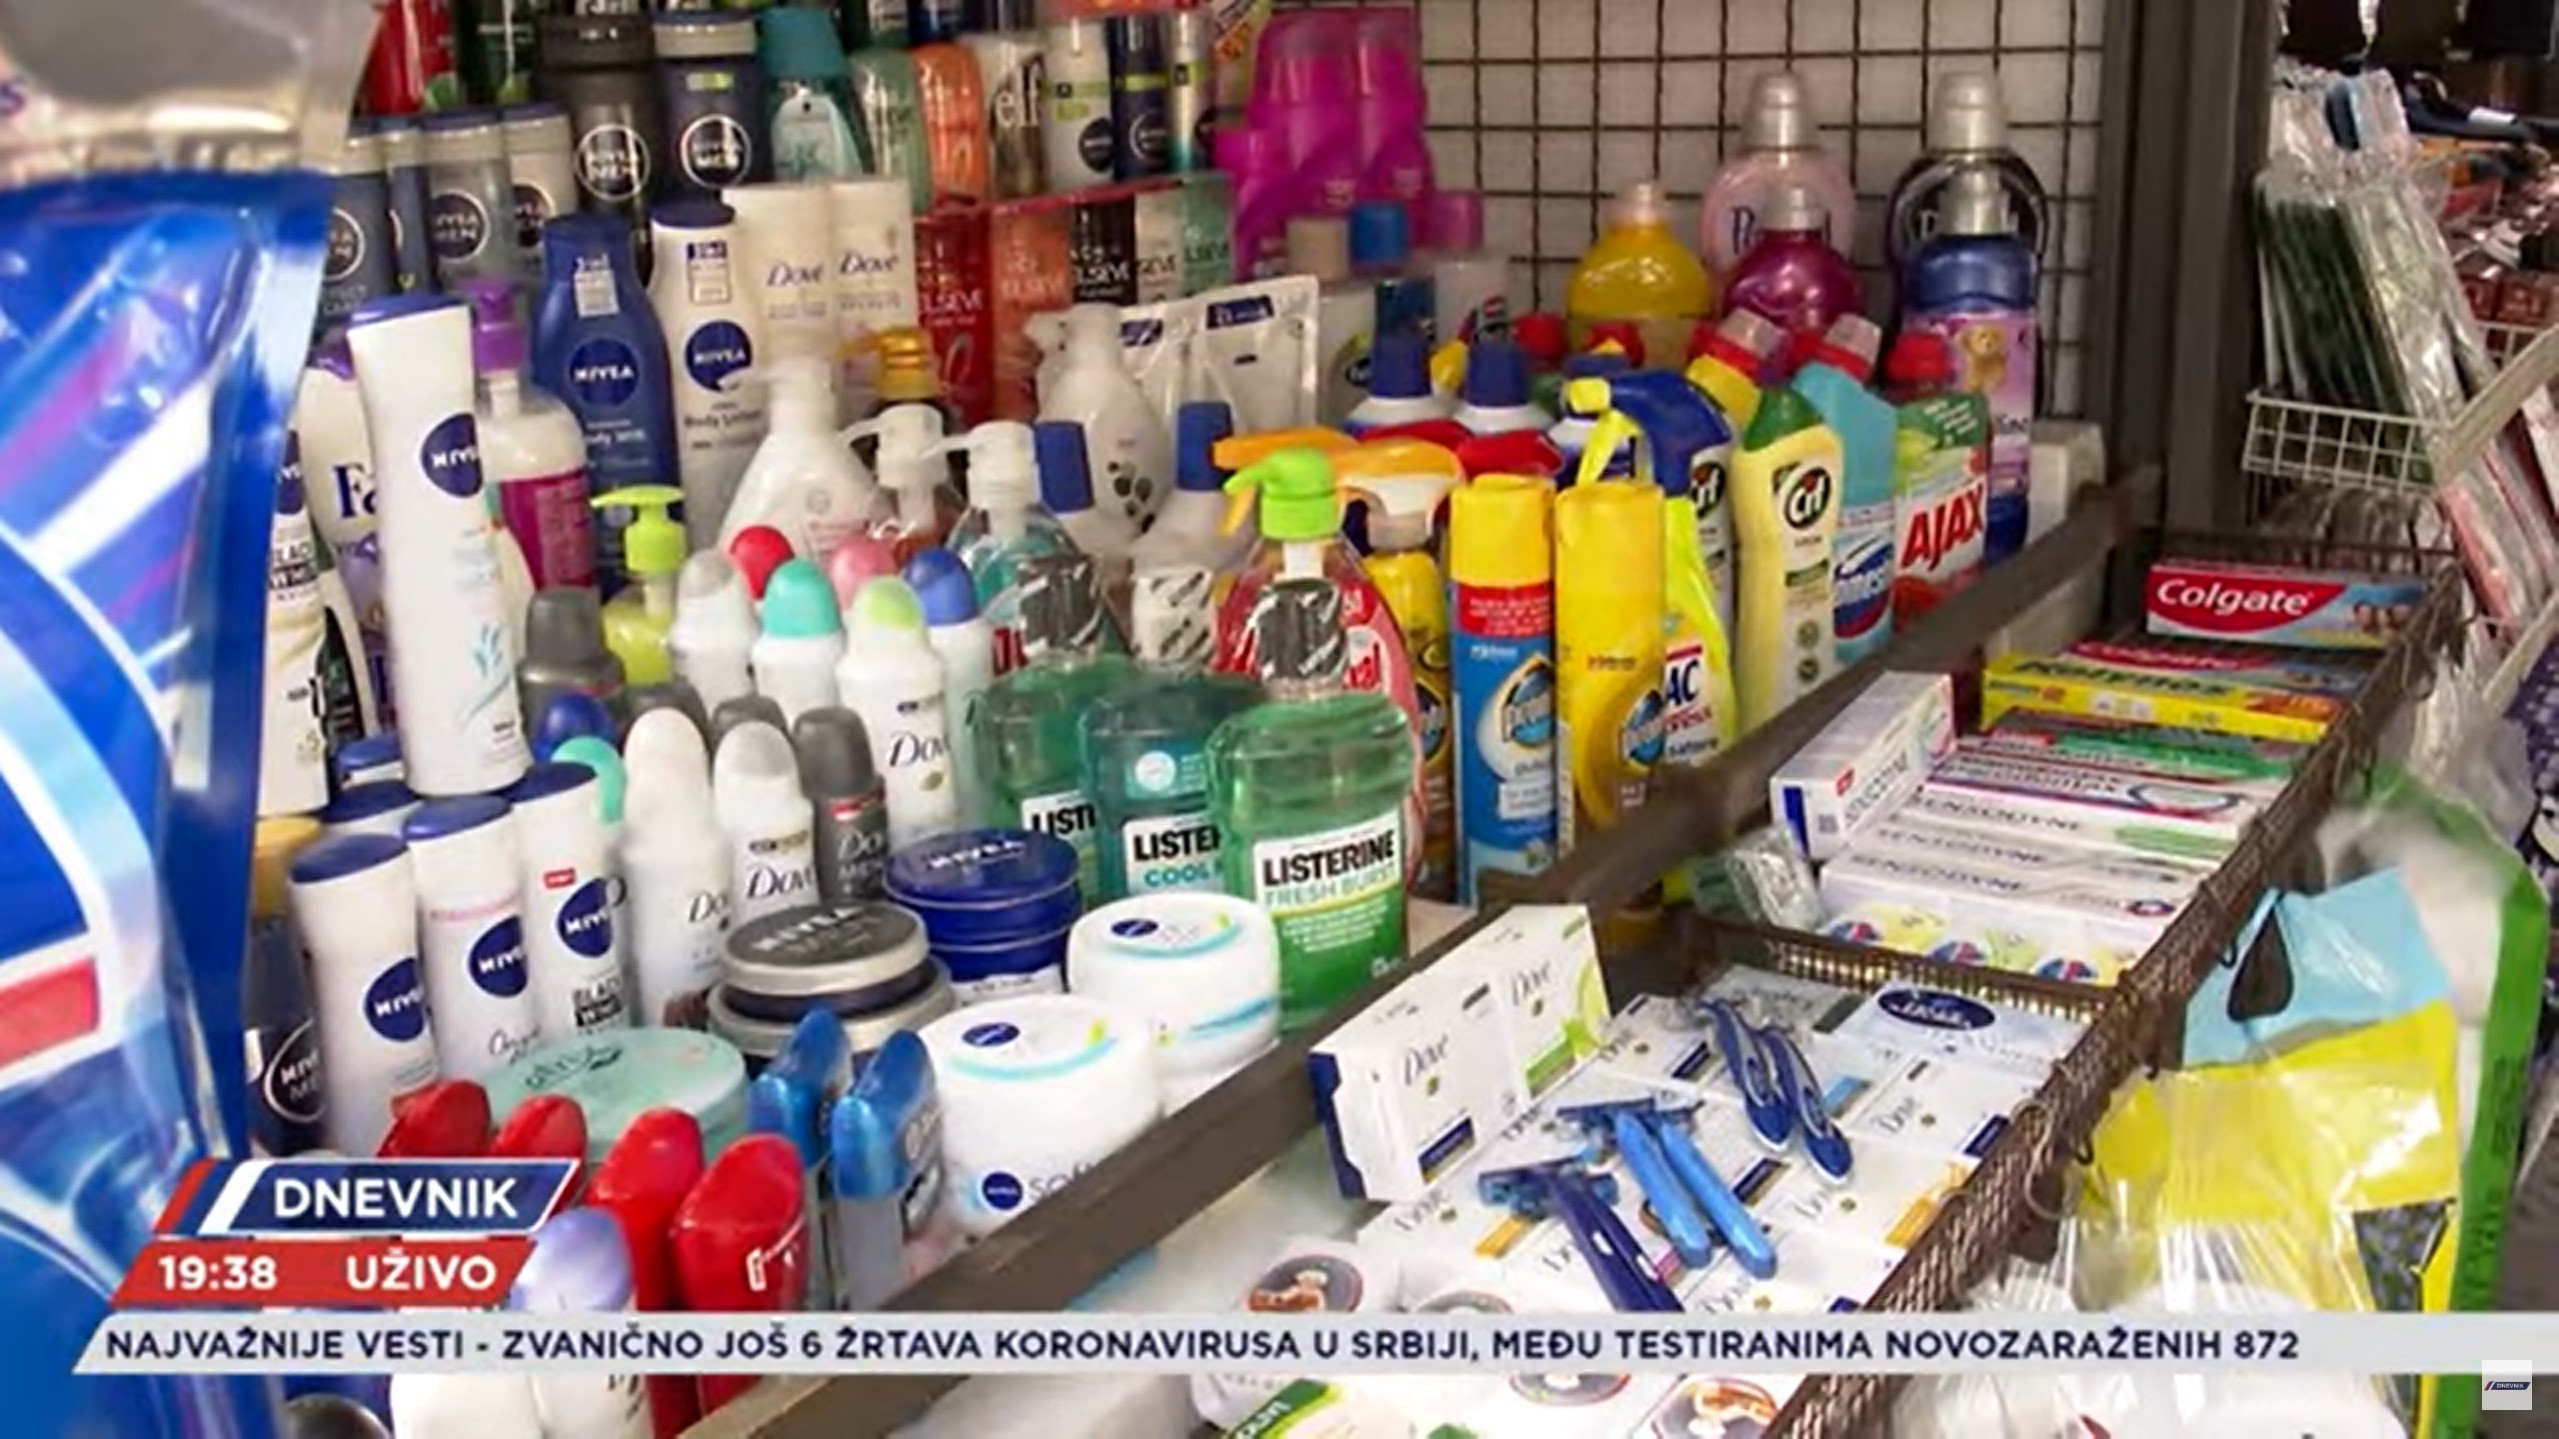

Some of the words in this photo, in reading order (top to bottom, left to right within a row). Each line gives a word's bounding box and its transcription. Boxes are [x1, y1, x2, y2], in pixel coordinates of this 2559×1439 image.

[573, 364, 635, 384] NIVEA
[692, 348, 748, 366] NIVEA
[1900, 480, 1985, 573] AJAX
[2155, 576, 2311, 618] Colgate
[1262, 828, 1396, 888] LISTERINE
[1850, 851, 2026, 893] SENSODYNE
